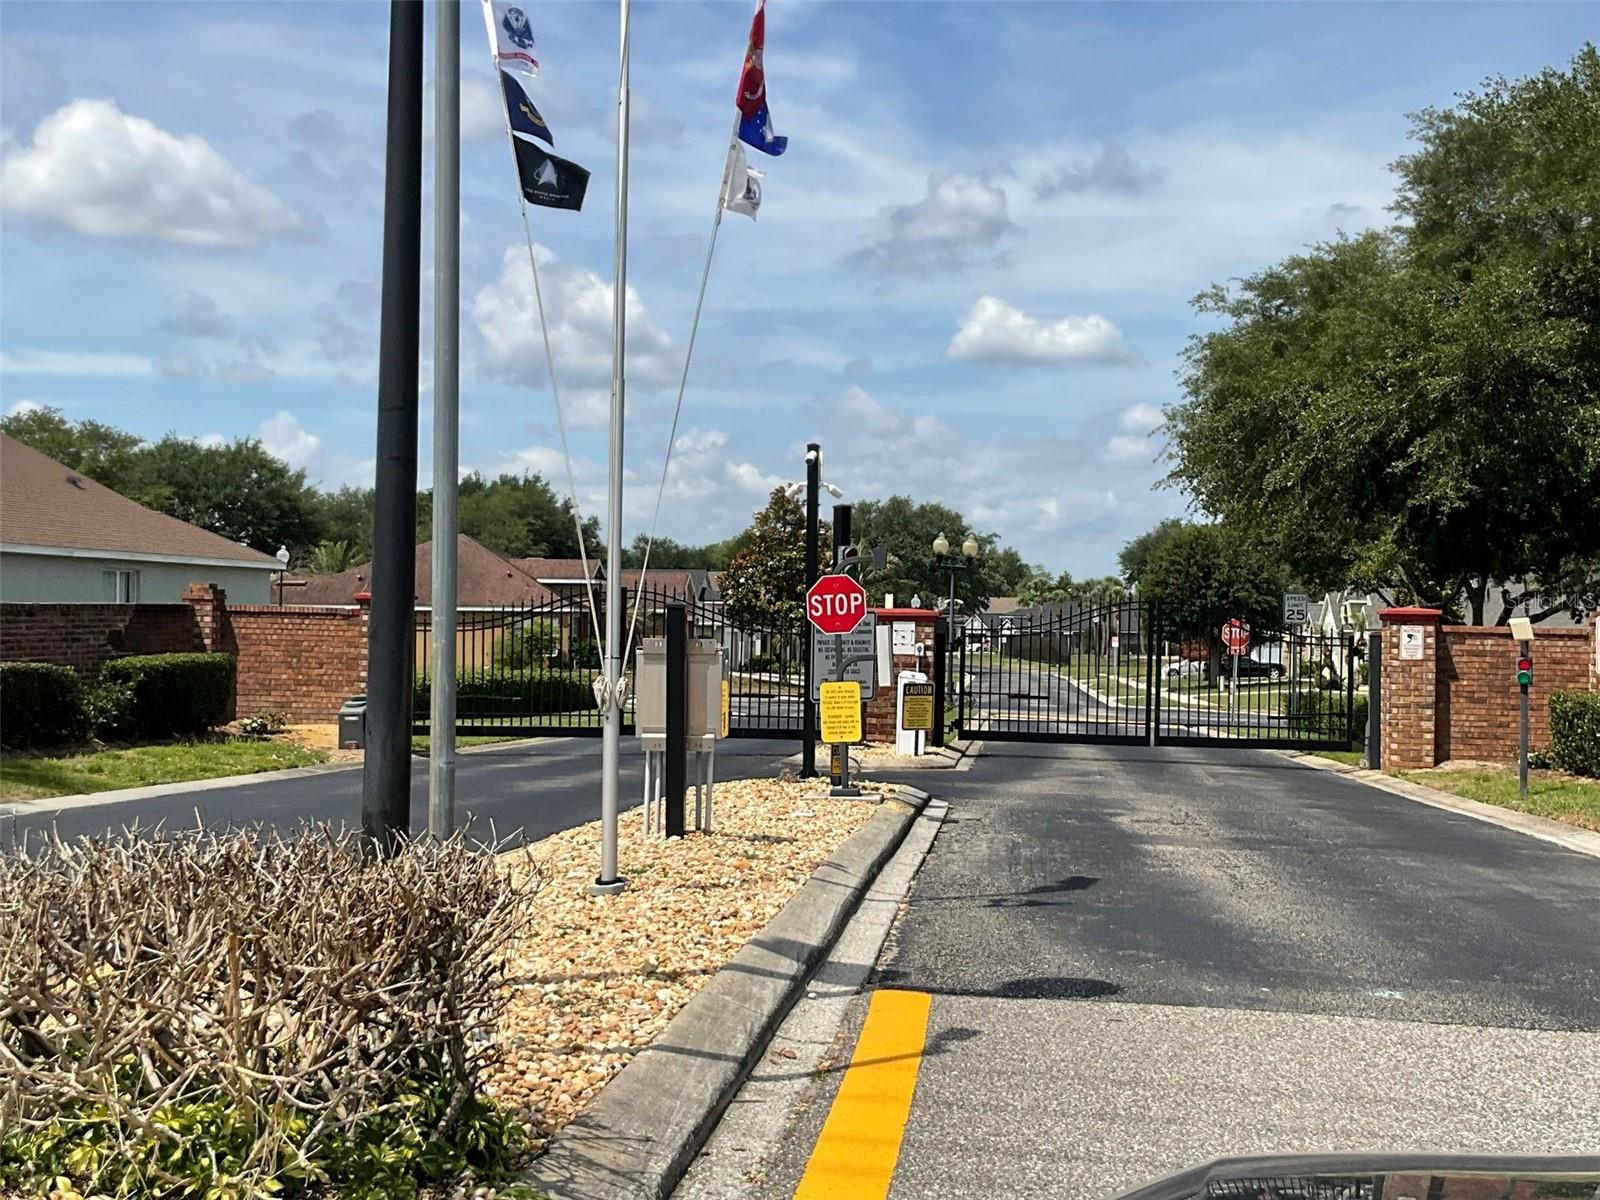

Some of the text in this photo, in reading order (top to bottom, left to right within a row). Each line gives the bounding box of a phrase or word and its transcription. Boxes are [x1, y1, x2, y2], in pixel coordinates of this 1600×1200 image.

[811, 593, 862, 616] STOP
[1286, 609, 1305, 621] 25
[1224, 627, 1249, 639] STOP
[905, 685, 932, 695] CAUTION
